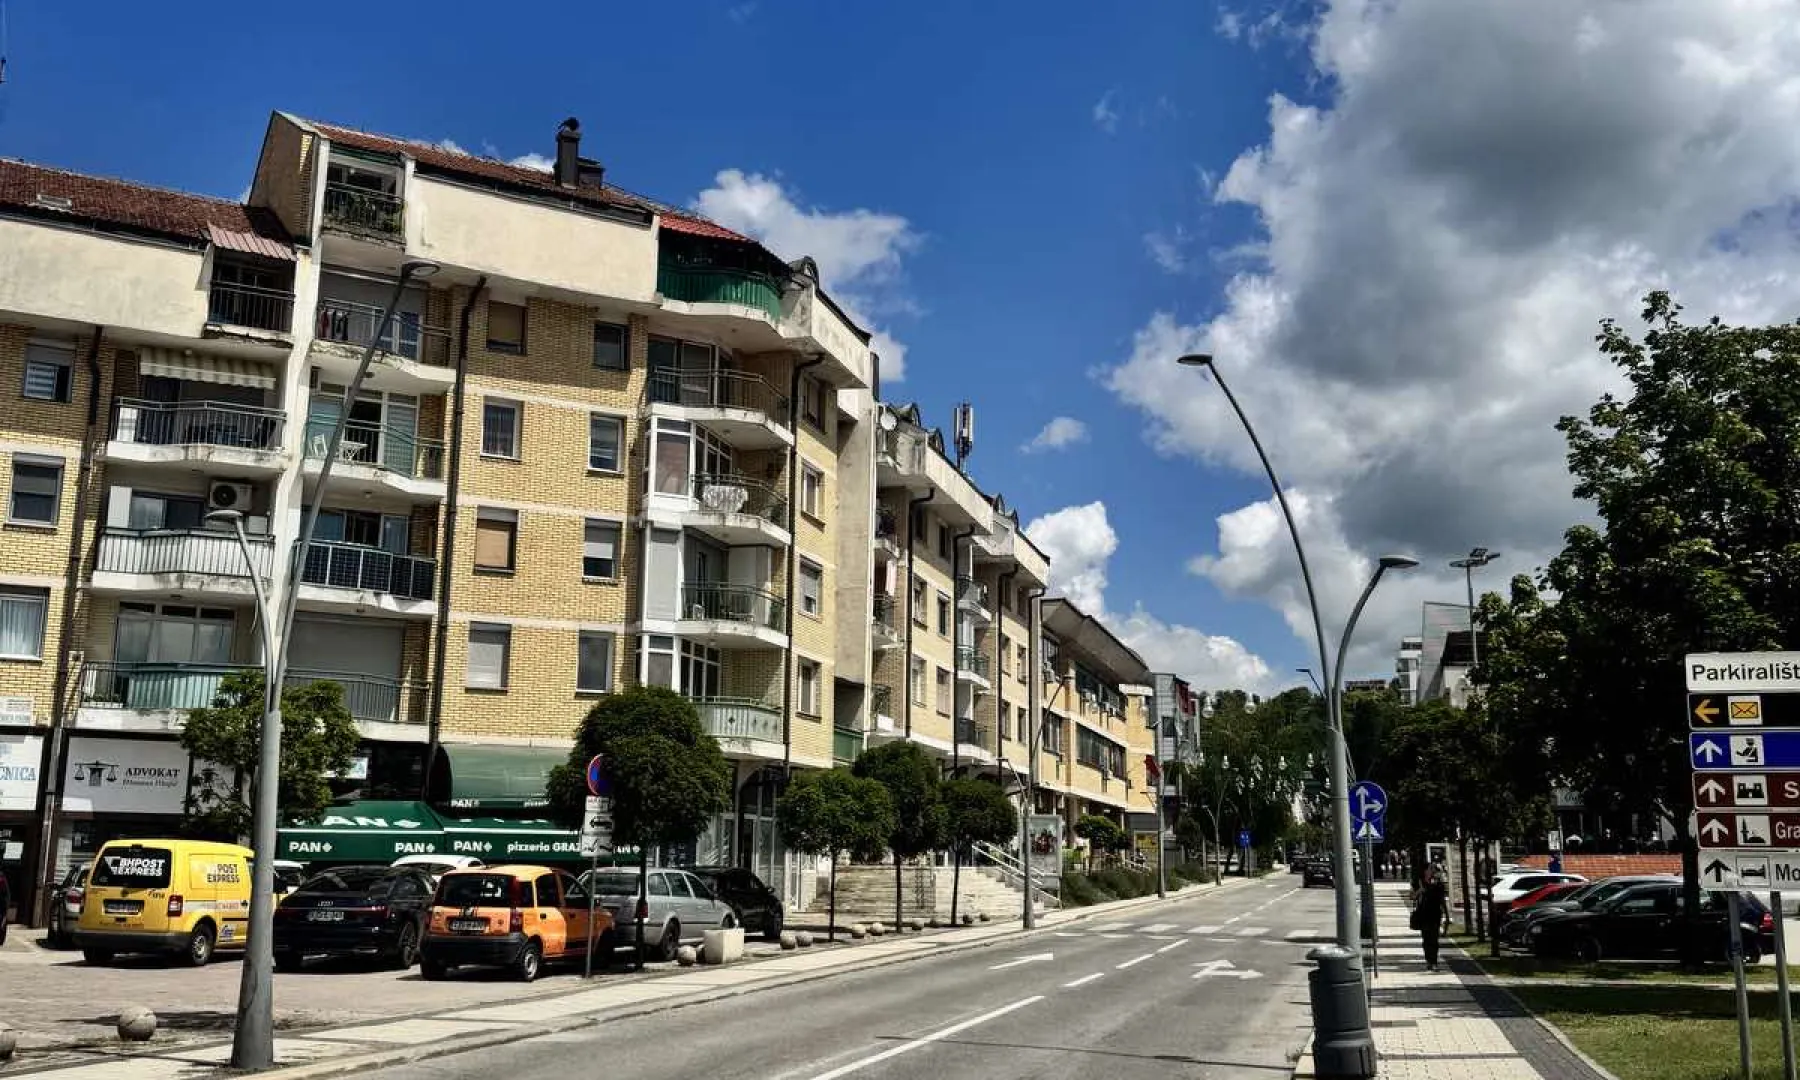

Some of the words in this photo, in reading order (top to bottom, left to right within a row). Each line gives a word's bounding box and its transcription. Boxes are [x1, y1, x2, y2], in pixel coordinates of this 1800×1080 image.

[1692, 662, 1800, 681] Parkirališt
[125, 767, 180, 778] ADVOKAT
[1784, 781, 1799, 799] S
[1775, 821, 1800, 839] Gra
[289, 842, 321, 853] PAN
[394, 842, 425, 853] PAN
[453, 841, 483, 852] PAN
[507, 841, 550, 855] pizzeria
[118, 867, 162, 877] EXPRESS
[1775, 863, 1800, 881] Mo
[207, 873, 240, 883] EXPRESS
